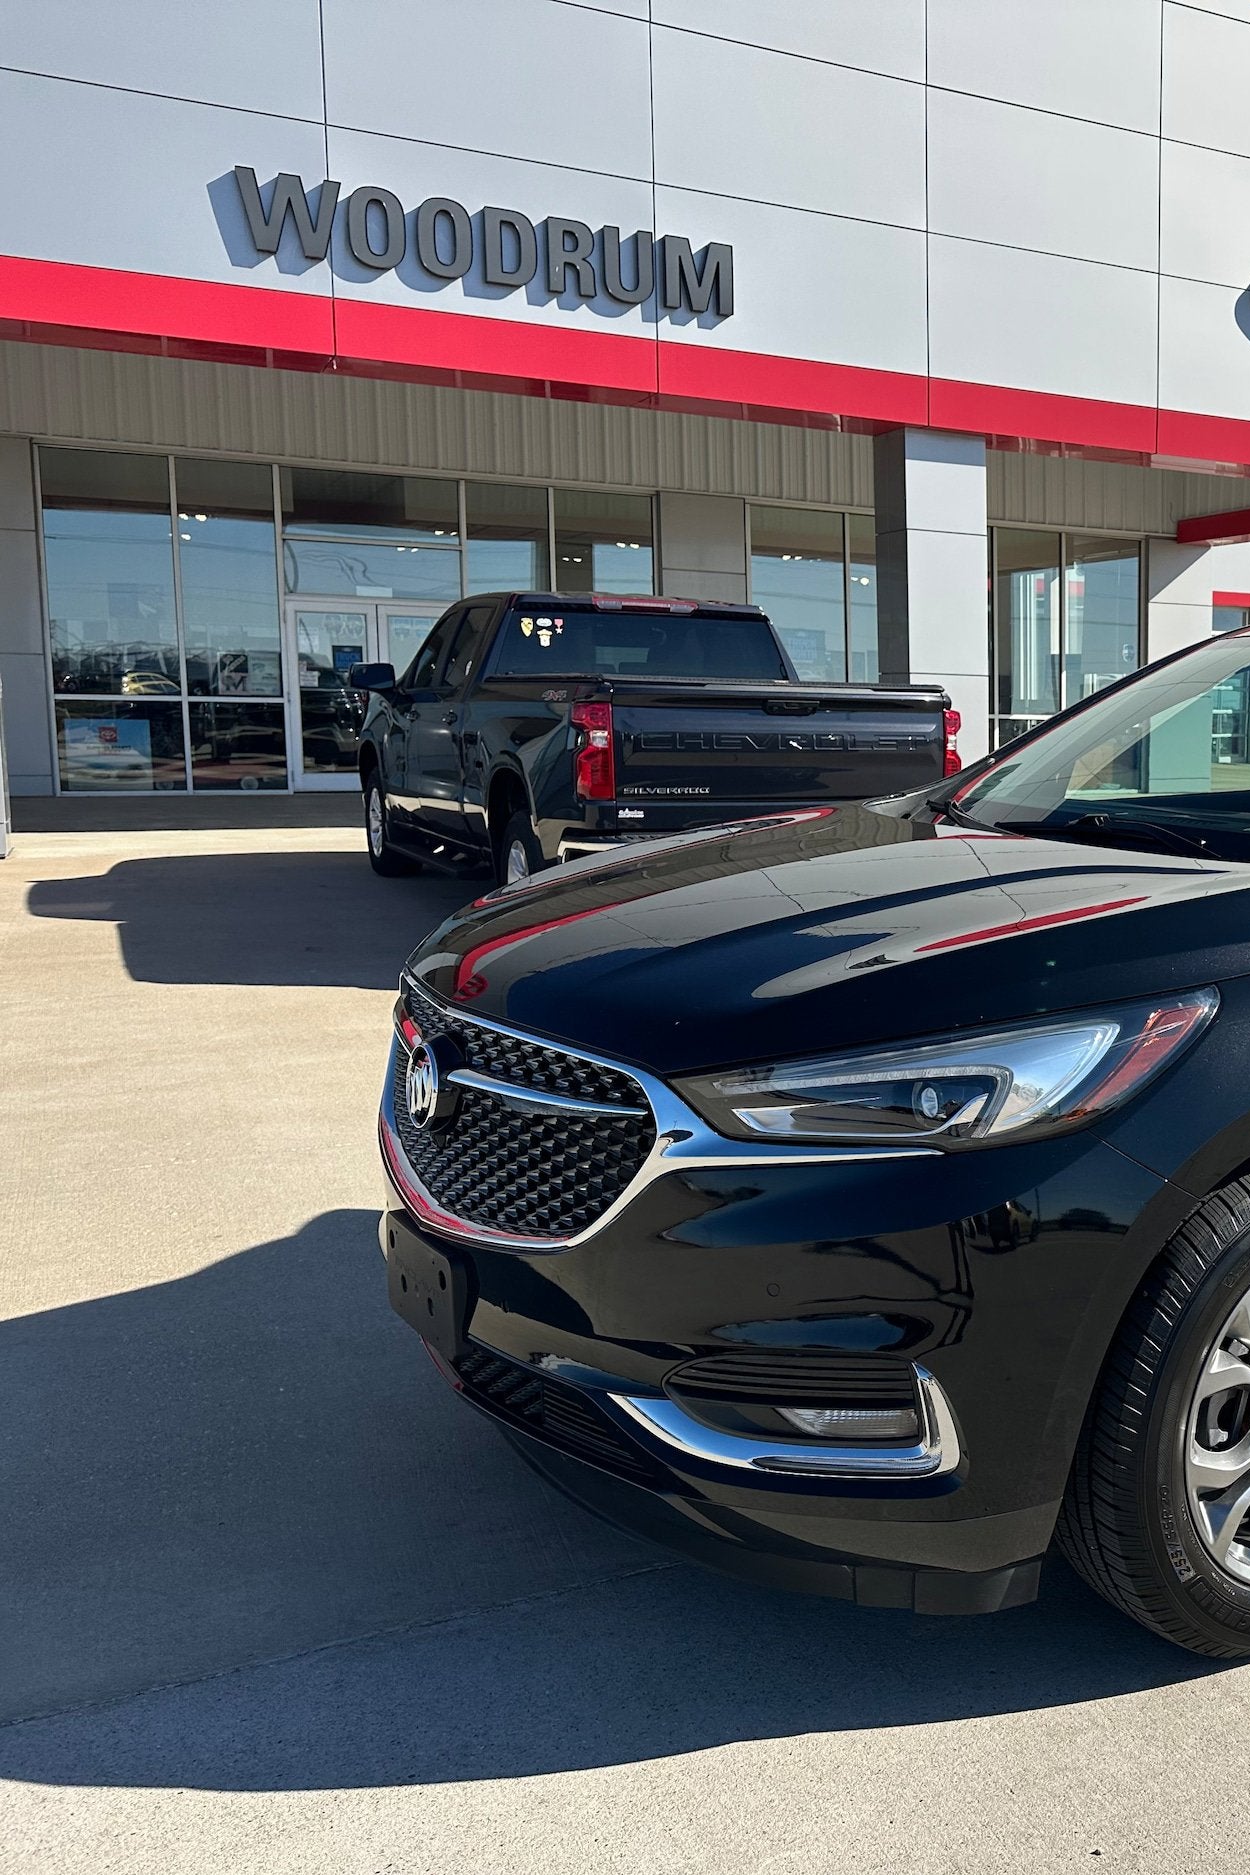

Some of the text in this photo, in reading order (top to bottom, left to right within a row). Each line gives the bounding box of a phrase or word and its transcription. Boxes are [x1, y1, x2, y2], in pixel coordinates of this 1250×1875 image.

[234, 165, 734, 317] WOODRUM
[640, 731, 930, 751] CHEVROLET
[623, 787, 710, 795] SILVERADO
